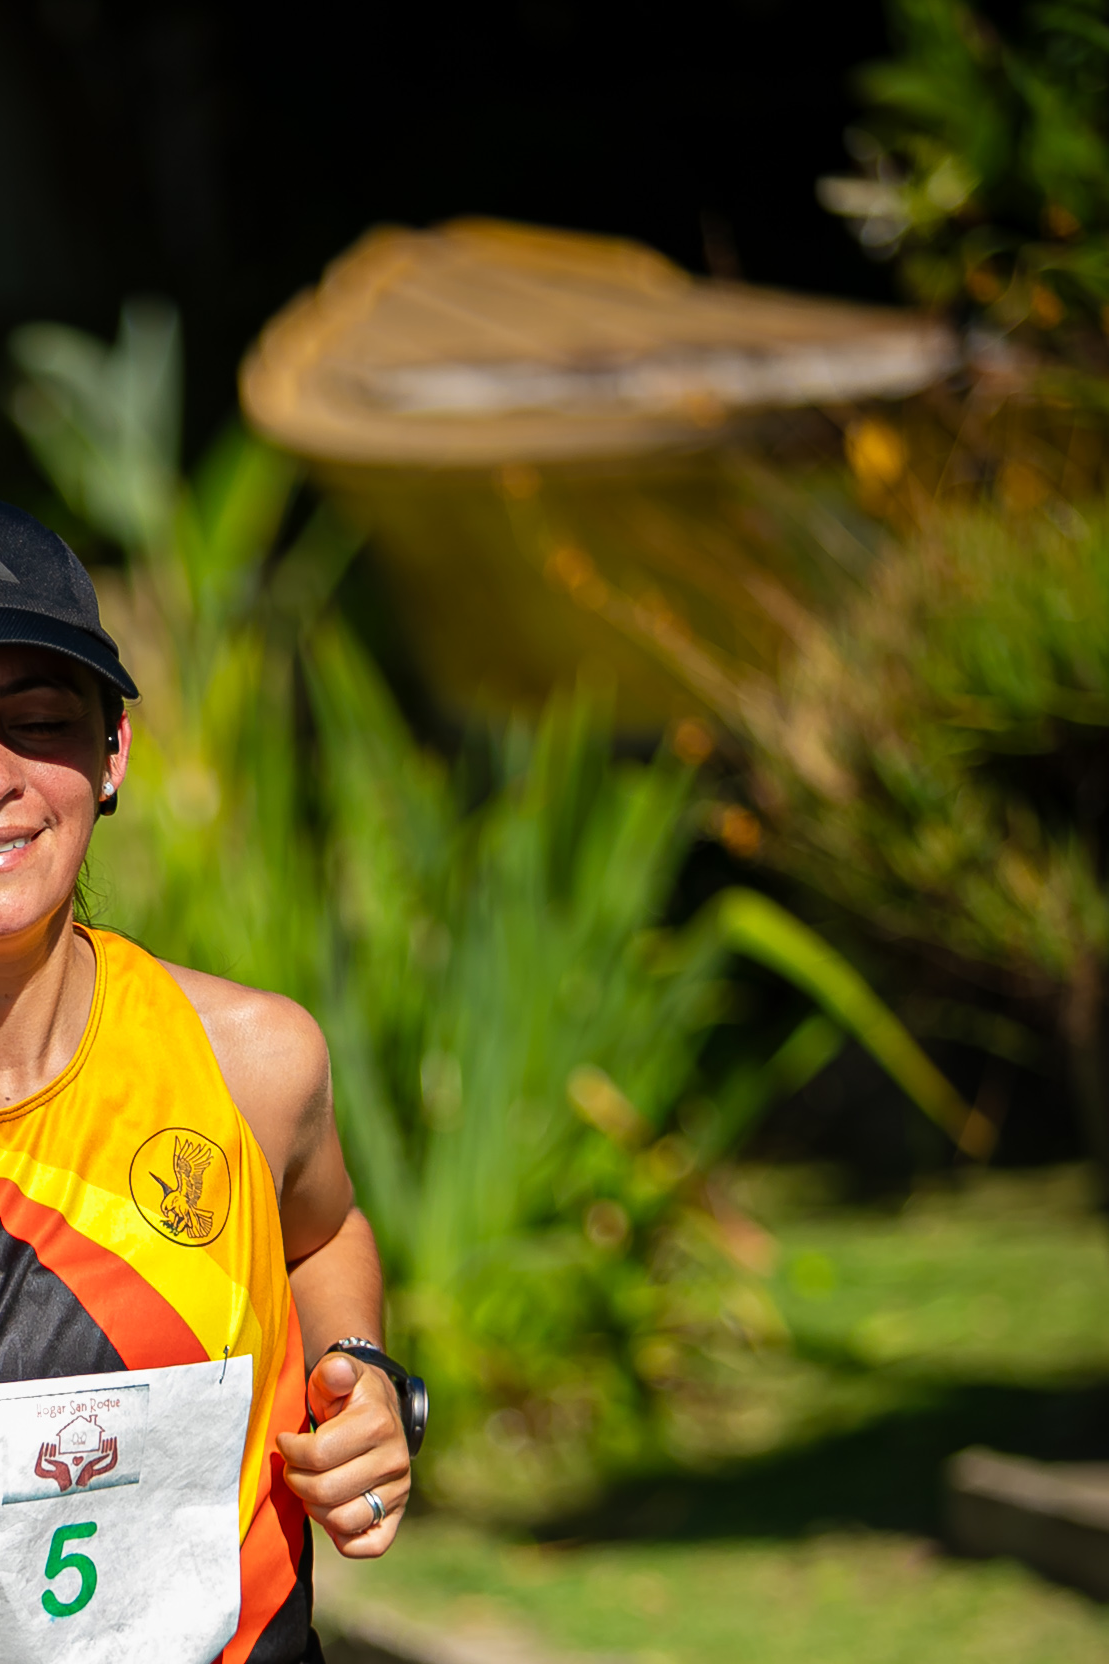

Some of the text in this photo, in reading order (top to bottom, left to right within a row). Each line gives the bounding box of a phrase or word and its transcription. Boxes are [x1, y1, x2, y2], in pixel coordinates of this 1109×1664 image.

[36, 1398, 121, 1418] Hogar San Roque
[41, 1521, 98, 1618] 5
